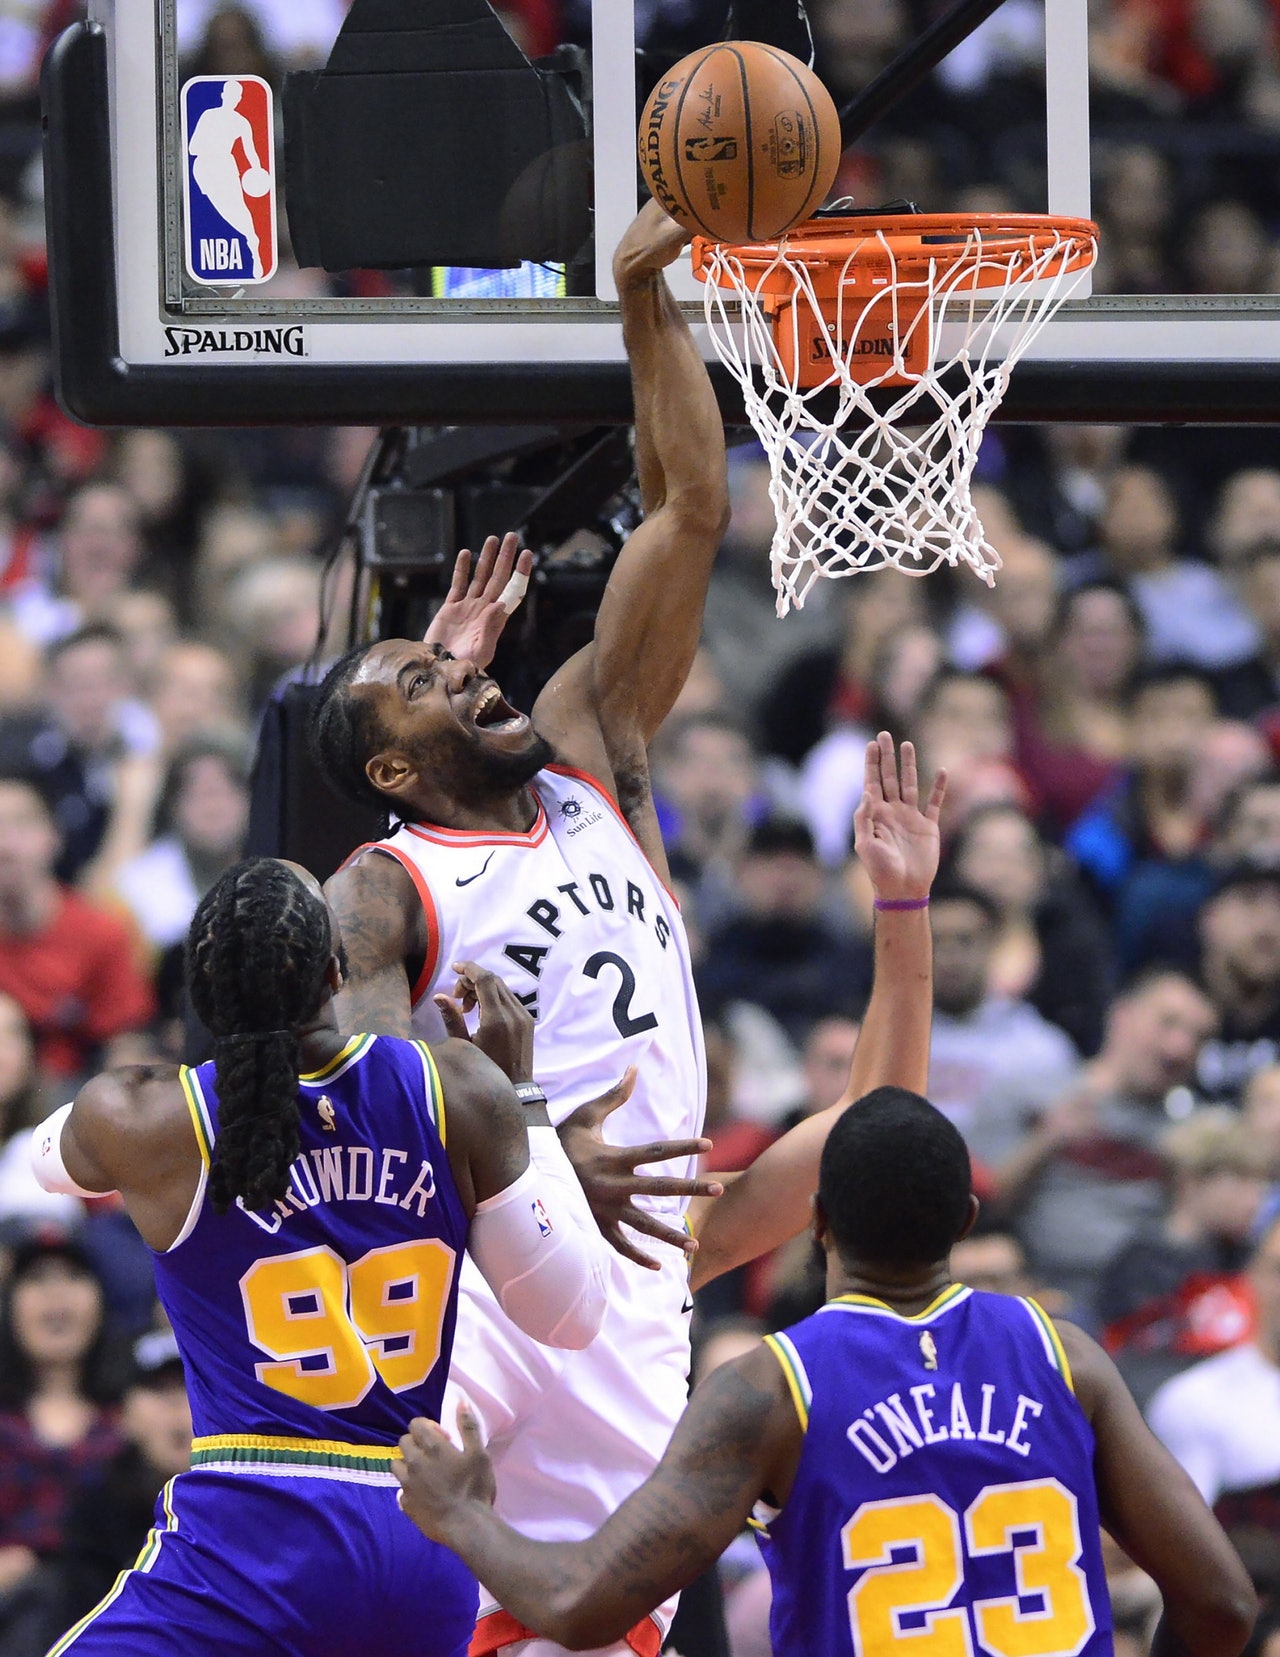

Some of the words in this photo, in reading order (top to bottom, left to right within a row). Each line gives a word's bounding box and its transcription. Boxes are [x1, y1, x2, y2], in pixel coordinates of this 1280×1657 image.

[648, 80, 687, 217] SPALDING
[200, 238, 243, 271] NBA
[164, 325, 304, 357] SPALDING
[566, 822, 587, 838] Sun
[584, 811, 604, 825] Life
[583, 950, 659, 1039] 2
[238, 1238, 457, 1412] 99
[846, 1382, 1044, 1474] O'NEALE
[840, 1476, 1097, 1657] 23
